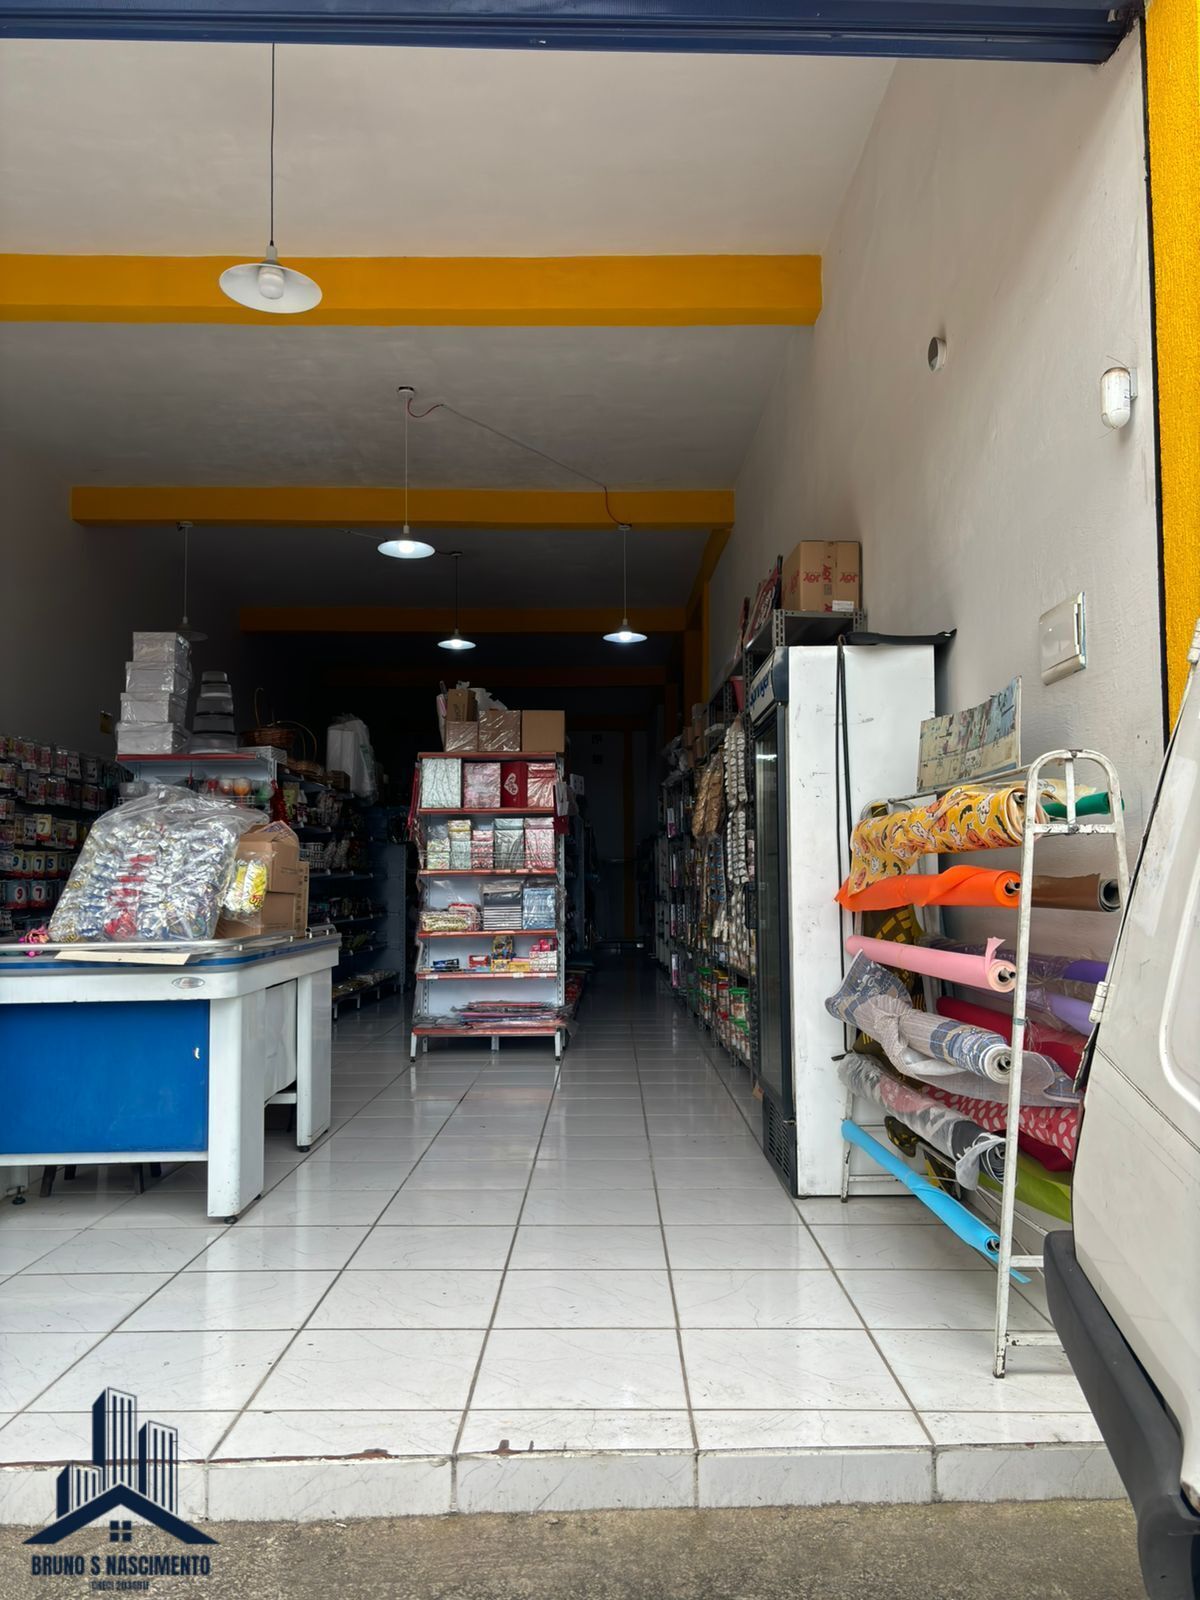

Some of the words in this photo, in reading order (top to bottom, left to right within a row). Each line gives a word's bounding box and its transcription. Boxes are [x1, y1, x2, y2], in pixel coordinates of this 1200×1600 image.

[39, 822, 46, 833] 7
[12, 856, 19, 867] 9
[36, 859, 42, 870] 7
[47, 858, 54, 868] 5
[17, 887, 23, 899] 9
[35, 887, 42, 899] 7
